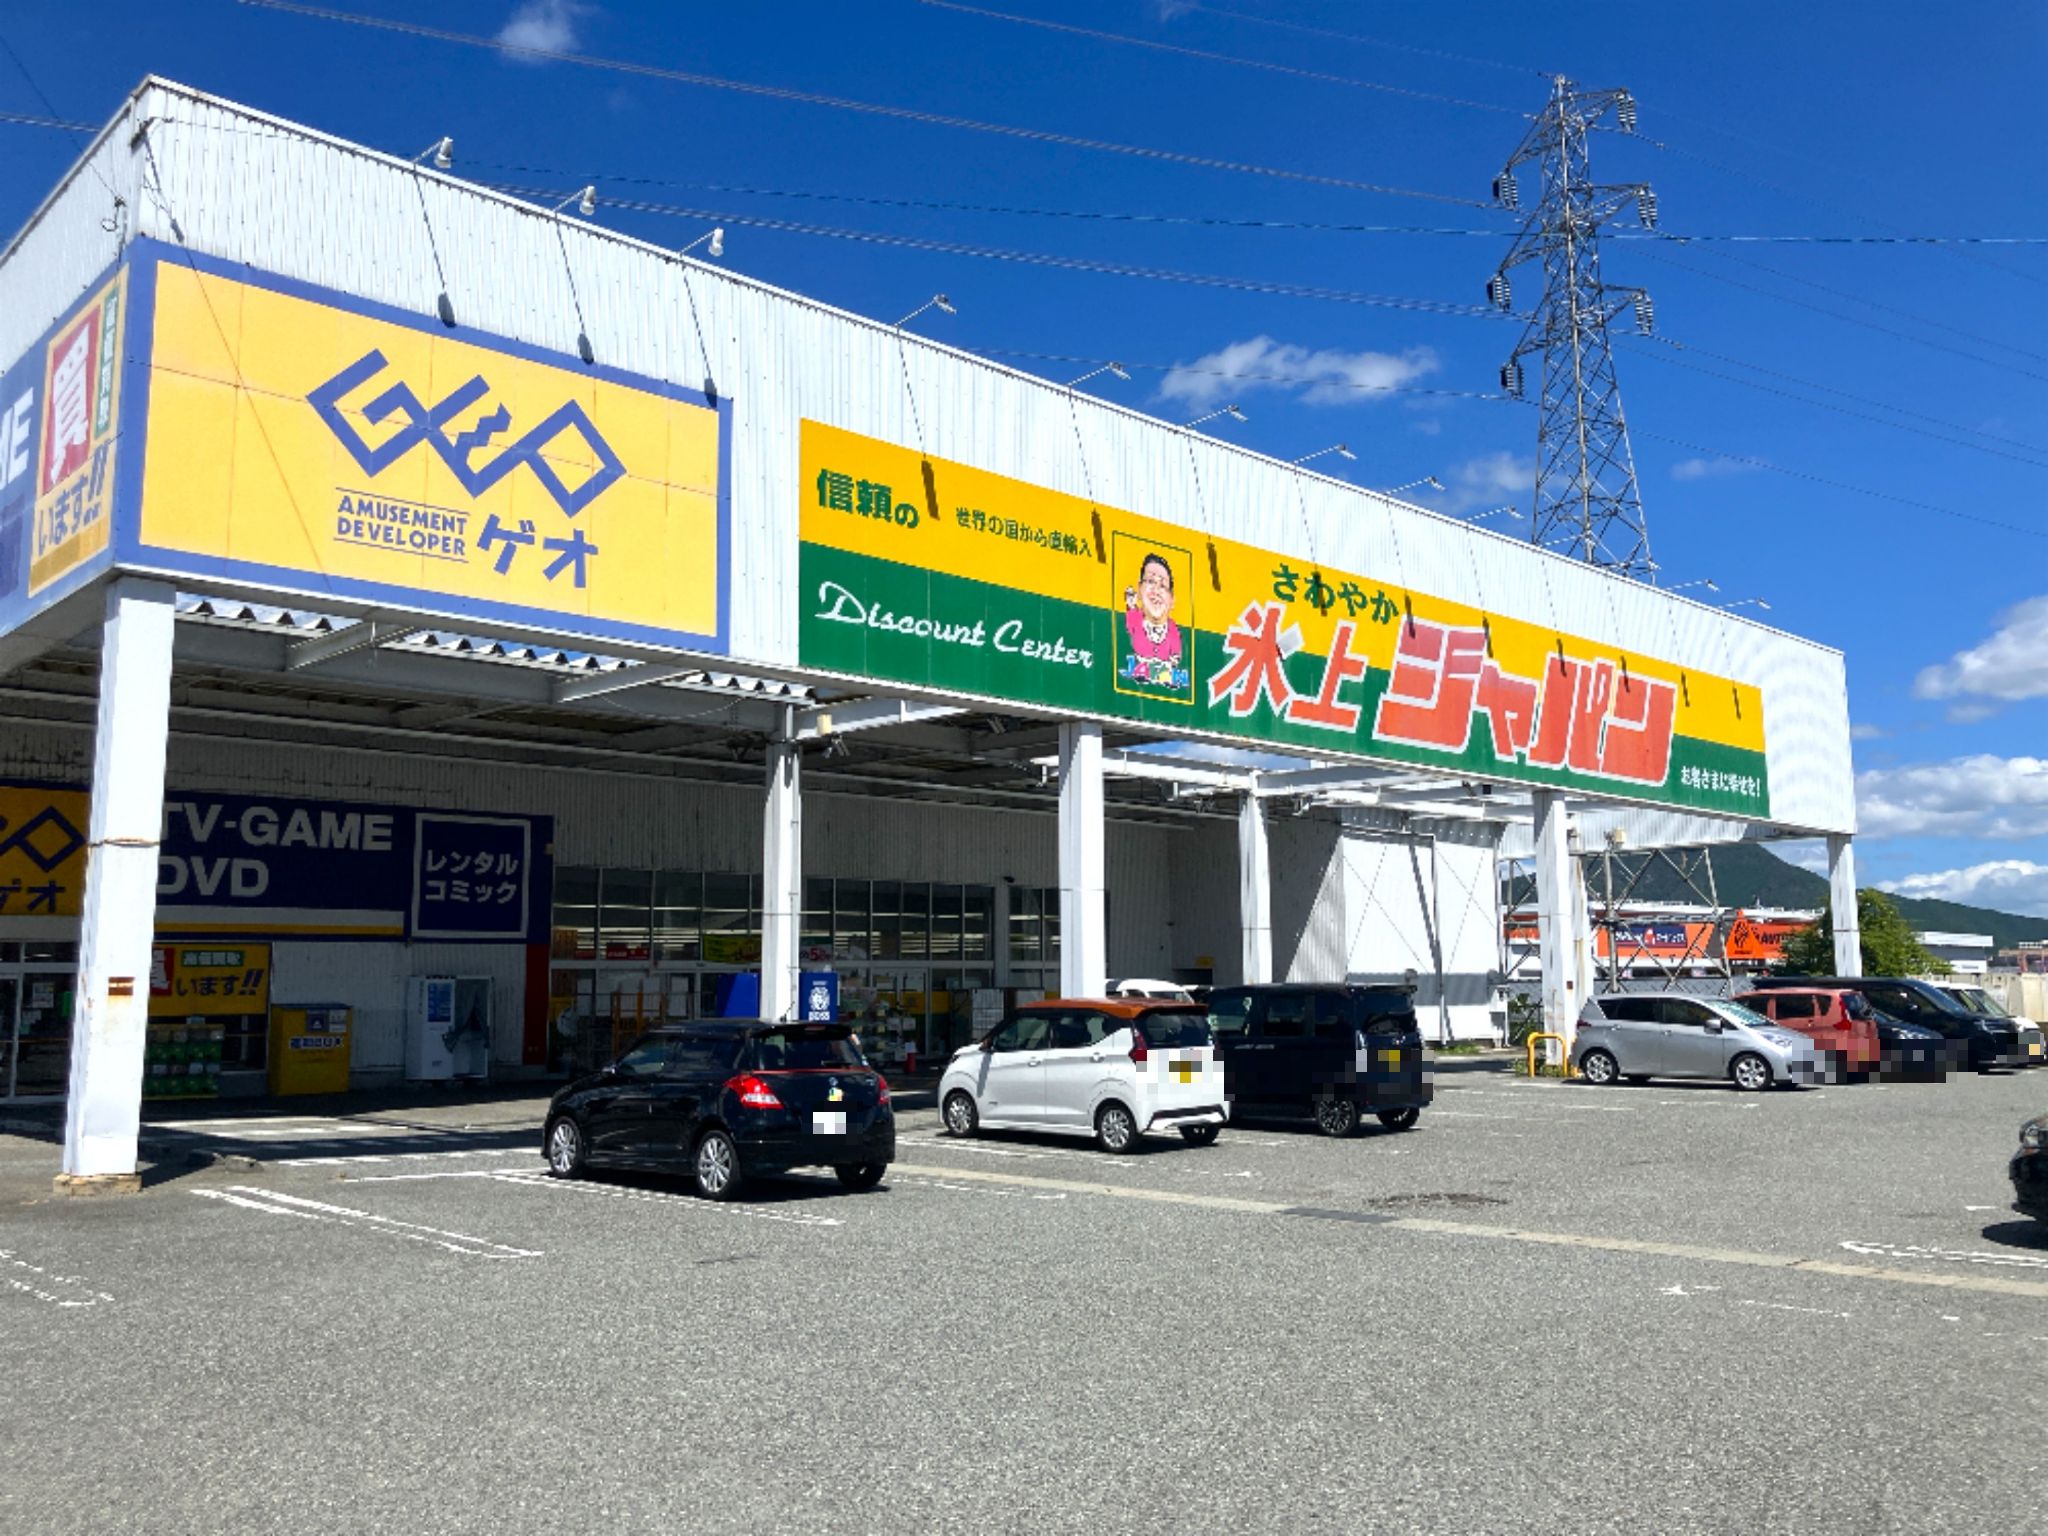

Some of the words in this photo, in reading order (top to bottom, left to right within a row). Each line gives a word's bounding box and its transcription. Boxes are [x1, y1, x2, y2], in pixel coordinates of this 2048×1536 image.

[51, 322, 90, 485] 買
[337, 494, 468, 536] AMUSEMENT
[816, 468, 920, 529] 信頼の
[336, 516, 467, 557] DEVELOPER
[476, 513, 599, 589] ゲオ
[955, 507, 1093, 558] 世界の国から直輸入
[814, 580, 986, 647] Discount
[993, 620, 1094, 669] Center
[1271, 563, 1400, 625] さわやか
[1207, 600, 1677, 788] 氷上ジャパン
[425, 849, 519, 876] レンタル
[425, 879, 518, 903] コミック
